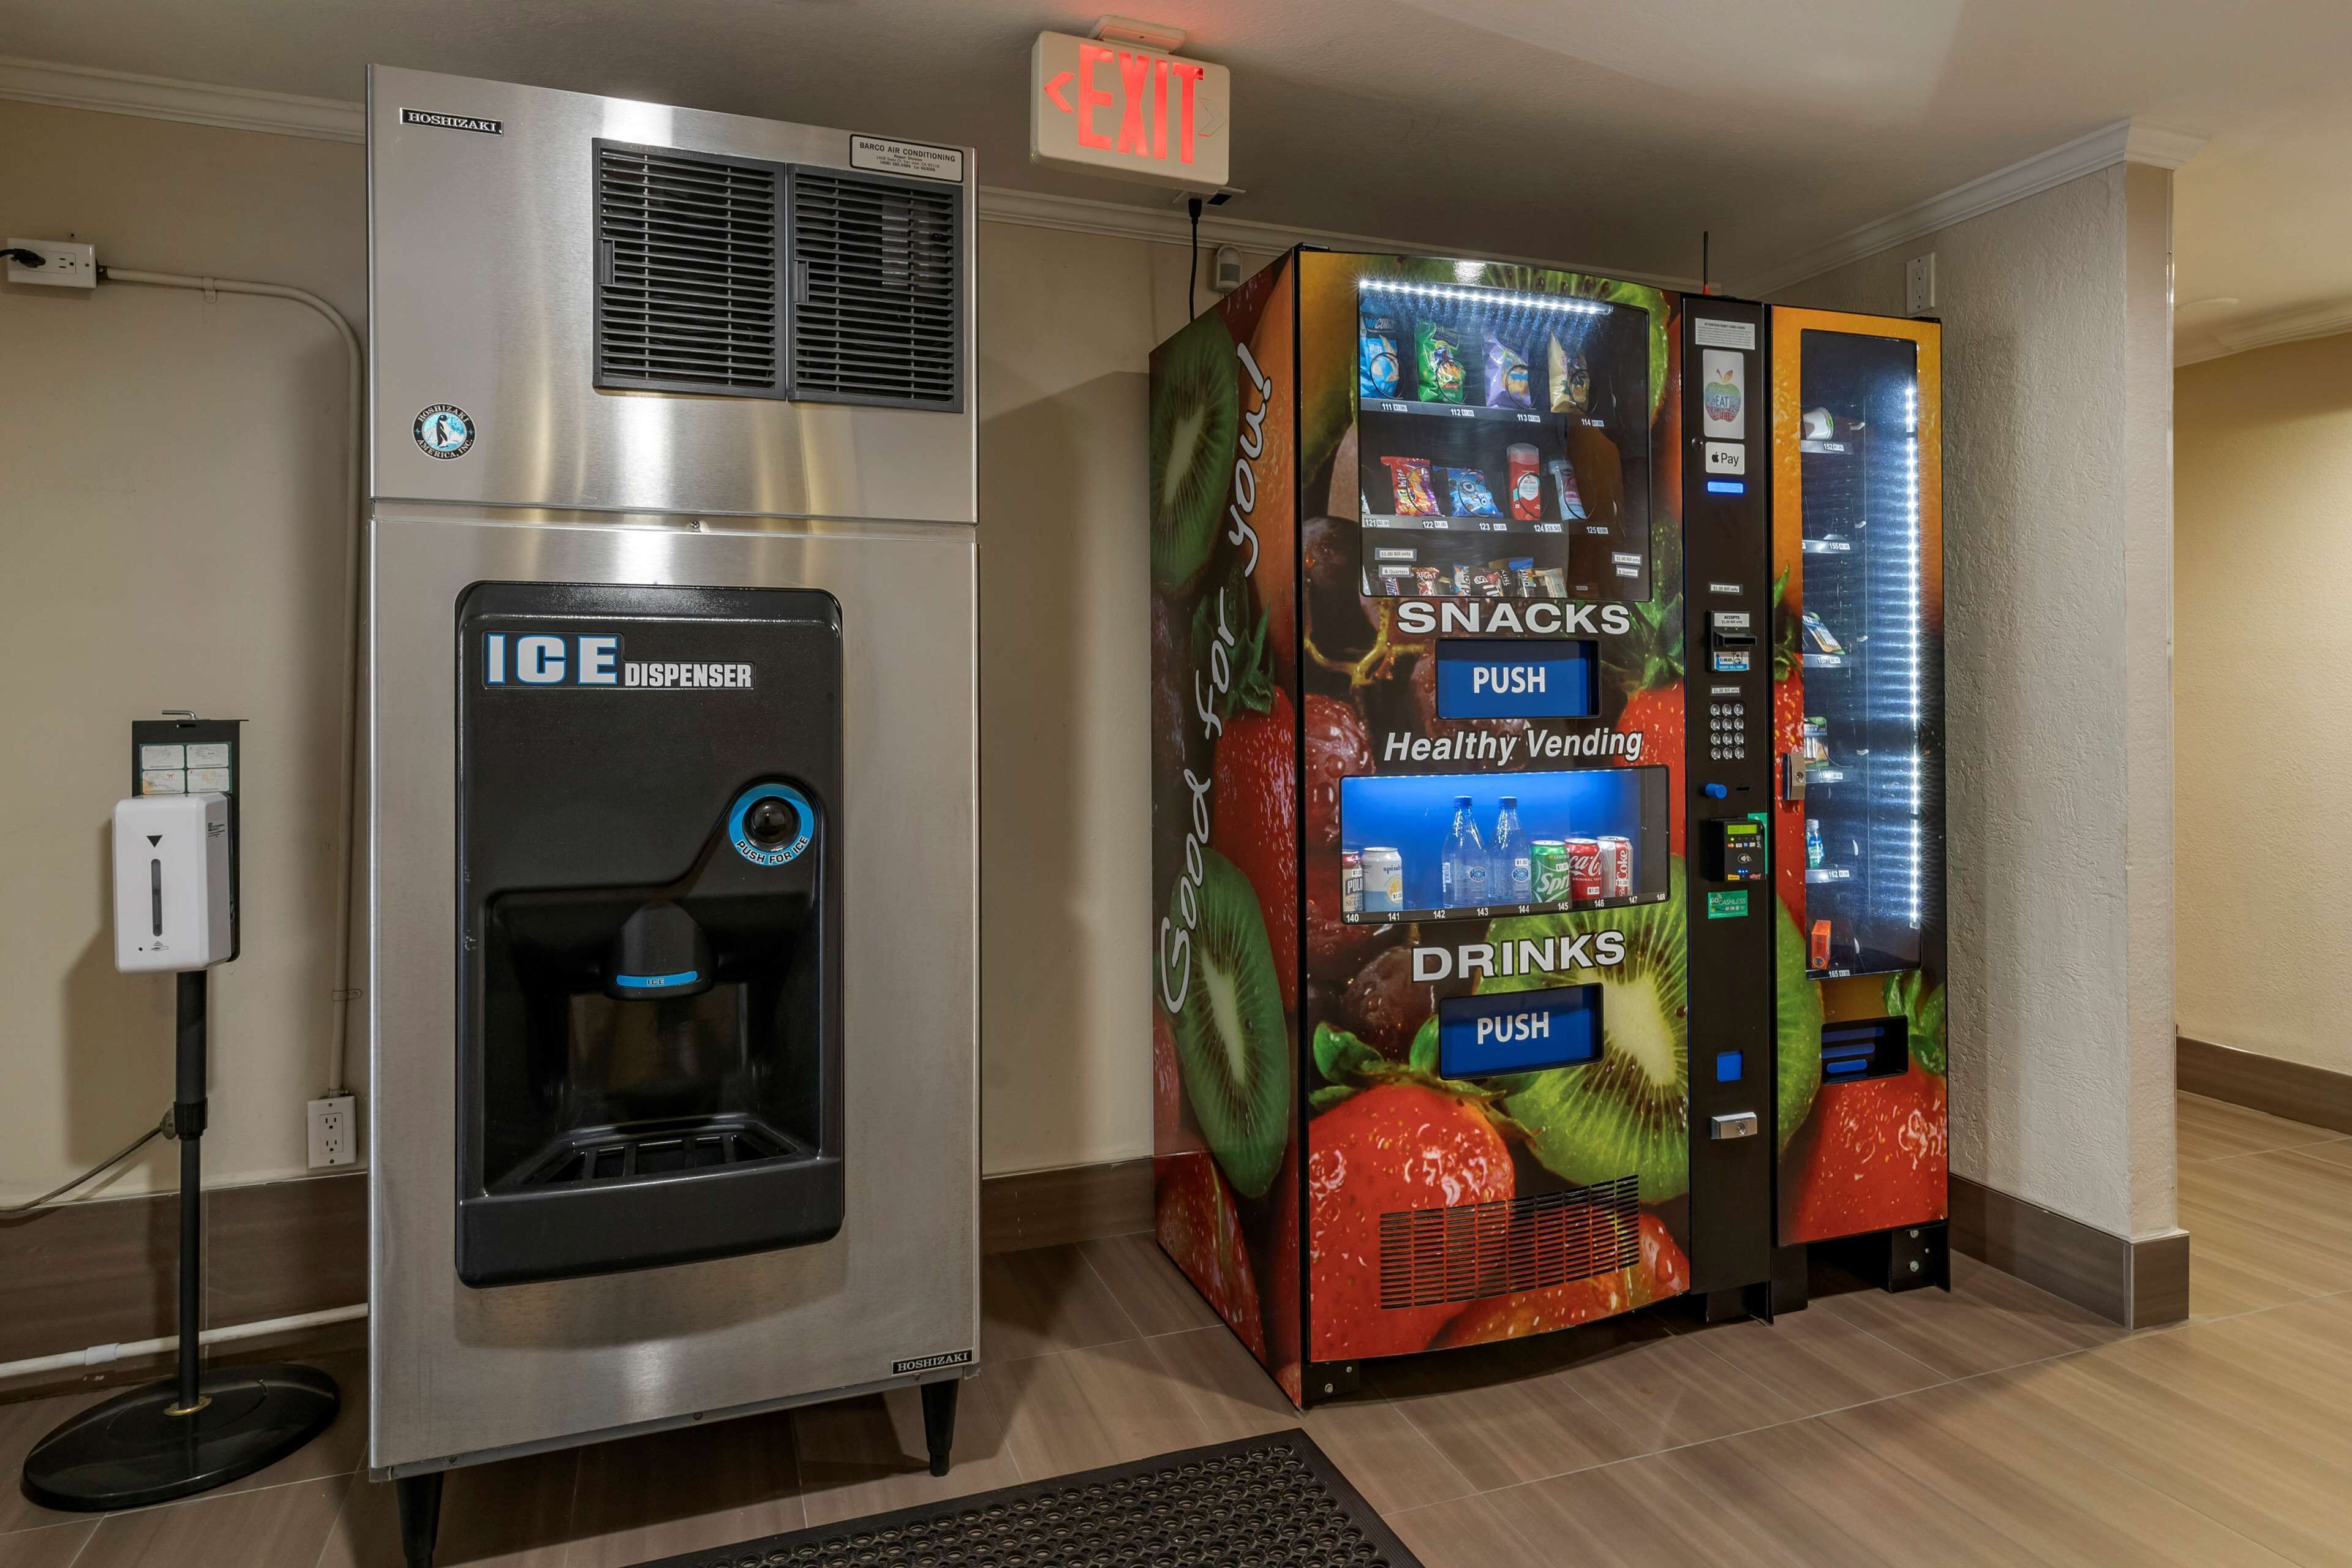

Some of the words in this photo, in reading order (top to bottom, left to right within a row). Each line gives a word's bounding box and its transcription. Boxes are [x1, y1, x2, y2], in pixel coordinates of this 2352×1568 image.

[1078, 43, 1204, 165] EXIT
[407, 112, 496, 132] HOSHIZAKI
[859, 141, 885, 152] BARCO
[888, 146, 900, 154] AIR
[903, 148, 956, 162] CONDITIONING
[1381, 402, 1393, 411] 111
[1715, 395, 1730, 407] EAT
[417, 405, 470, 423] HOSHIZAKI
[1450, 408, 1462, 417] 112
[1517, 413, 1528, 422] 113
[1581, 418, 1592, 427] 114
[417, 439, 459, 458] AMERICA,
[458, 439, 473, 454] INC.
[1721, 453, 1740, 467] Pay
[1365, 518, 1377, 527] 121
[1422, 520, 1434, 529] 122
[1479, 522, 1490, 531] 123
[1586, 526, 1597, 534] 125
[1415, 571, 1437, 579] RIGHT
[1397, 601, 1630, 635] SNACKS
[488, 633, 617, 685] ICE
[624, 663, 752, 688] DISPENSER
[1161, 767, 1212, 1015] Good
[1196, 586, 1235, 740] for
[1227, 342, 1272, 578] you!
[1473, 666, 1545, 694] PUSH
[1384, 731, 1518, 766] Healthy
[1526, 728, 1642, 762] Vending
[736, 840, 766, 864] PUSH
[769, 851, 792, 864] FOR
[792, 836, 809, 854] ICE
[1616, 850, 1628, 880] Coke
[1347, 878, 1362, 895] POL
[1346, 913, 1359, 923] 140
[1387, 912, 1400, 921] 141
[1433, 910, 1446, 919] 142
[1477, 907, 1489, 916] 143
[1518, 905, 1530, 914] 144
[1558, 902, 1569, 911] 145
[1594, 899, 1605, 908] 146
[1412, 931, 1626, 982] DRINKS
[1477, 1011, 1550, 1045] PUSH
[897, 1352, 968, 1372] HOSHIZAKI
